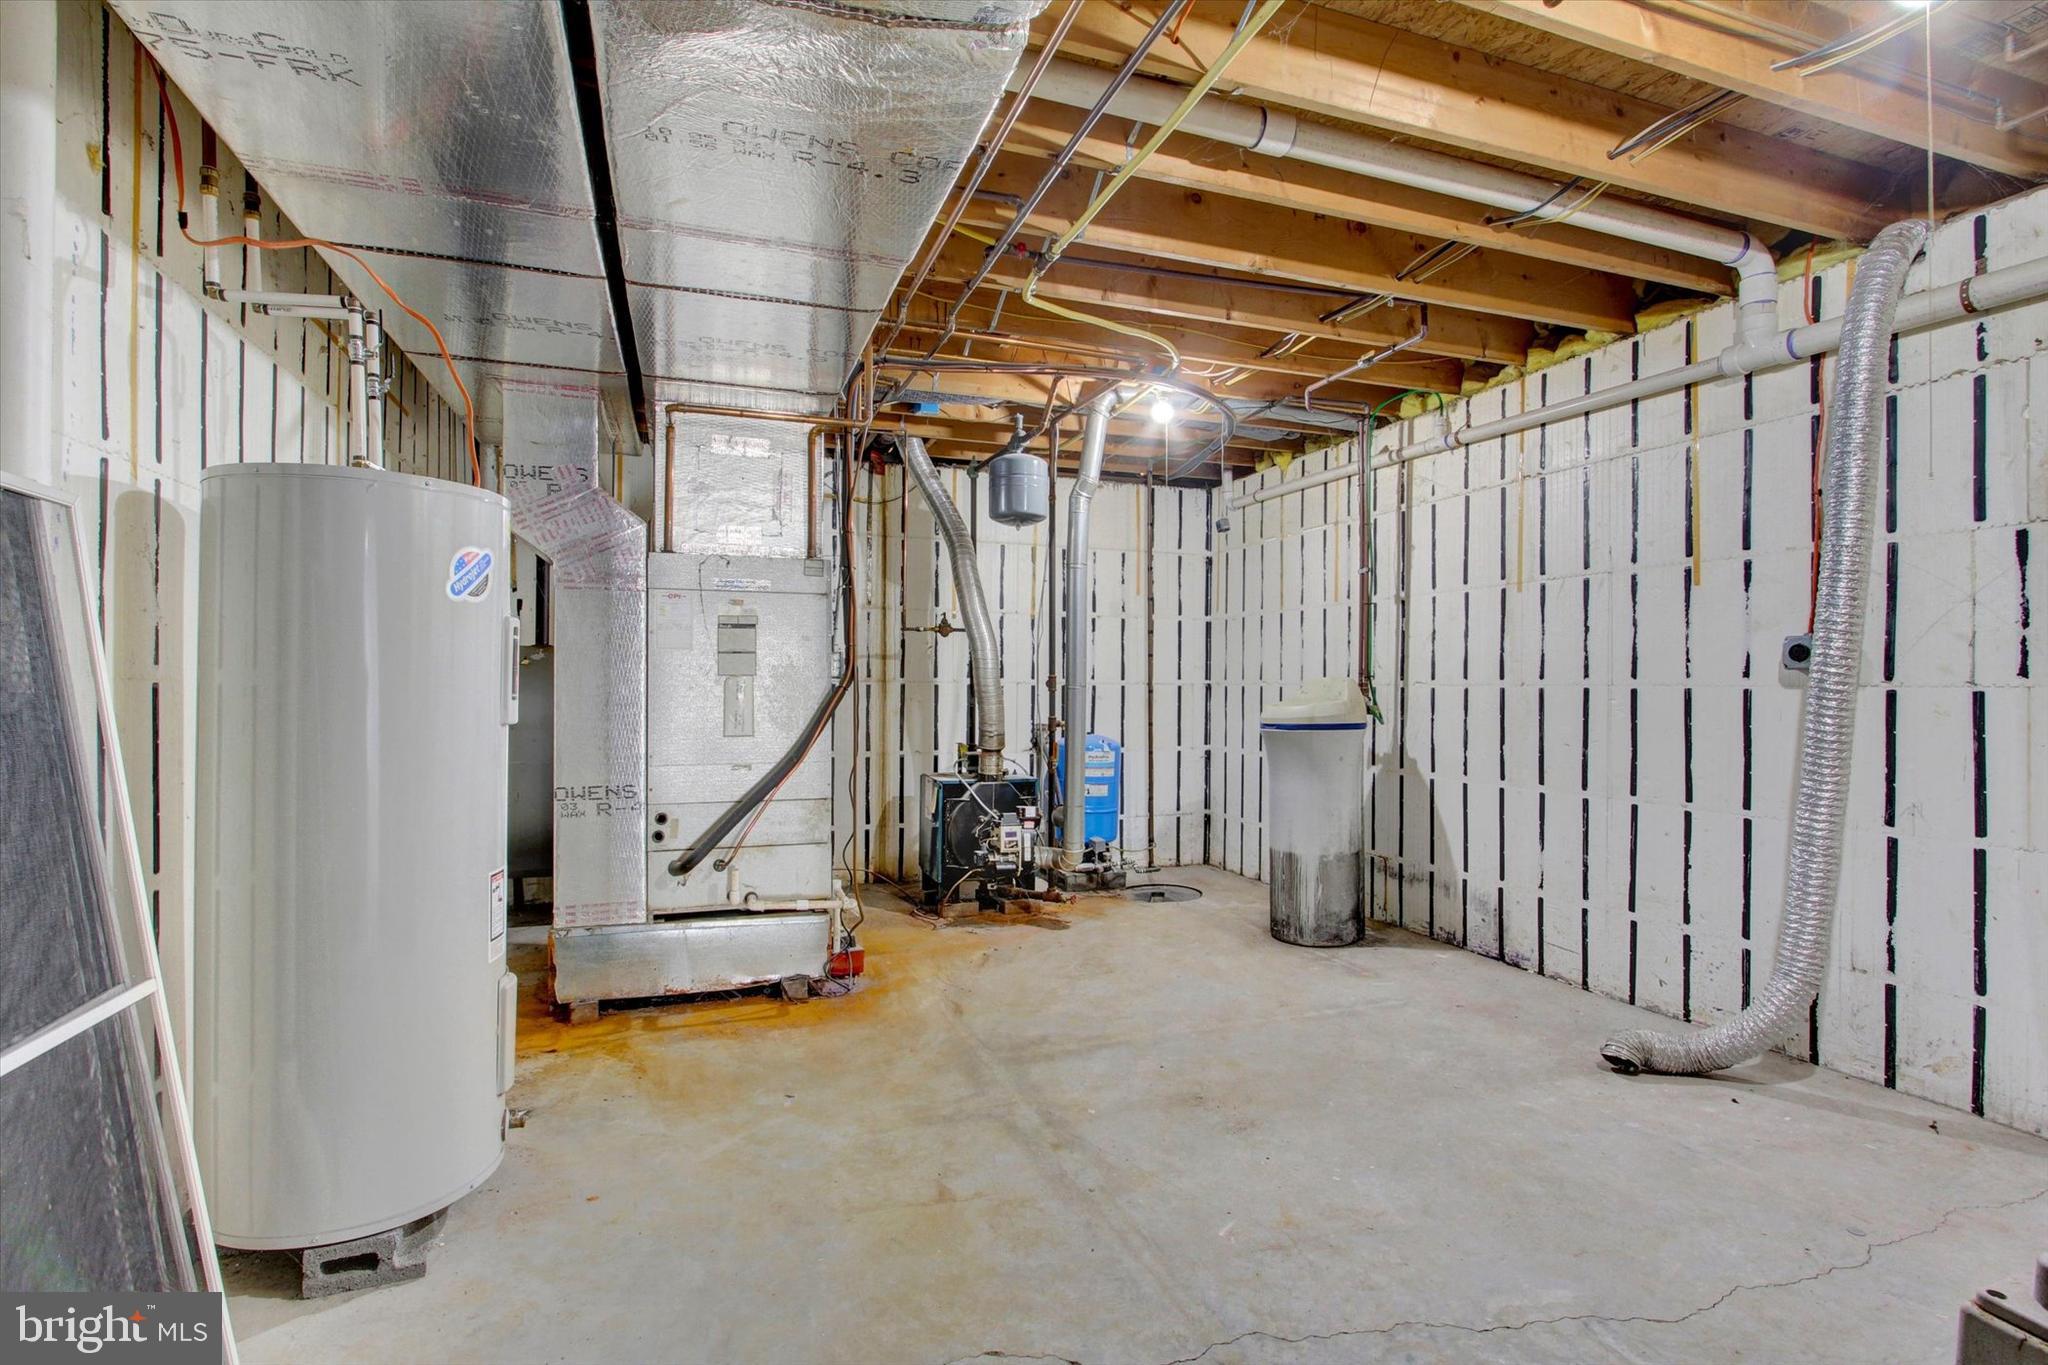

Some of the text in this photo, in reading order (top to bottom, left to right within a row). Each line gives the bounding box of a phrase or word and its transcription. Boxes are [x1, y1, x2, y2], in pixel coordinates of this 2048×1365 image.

[722, 121, 858, 156] OWENS
[492, 313, 592, 331] OWENS
[503, 464, 588, 482] OWES
[554, 784, 637, 801] OWENS
